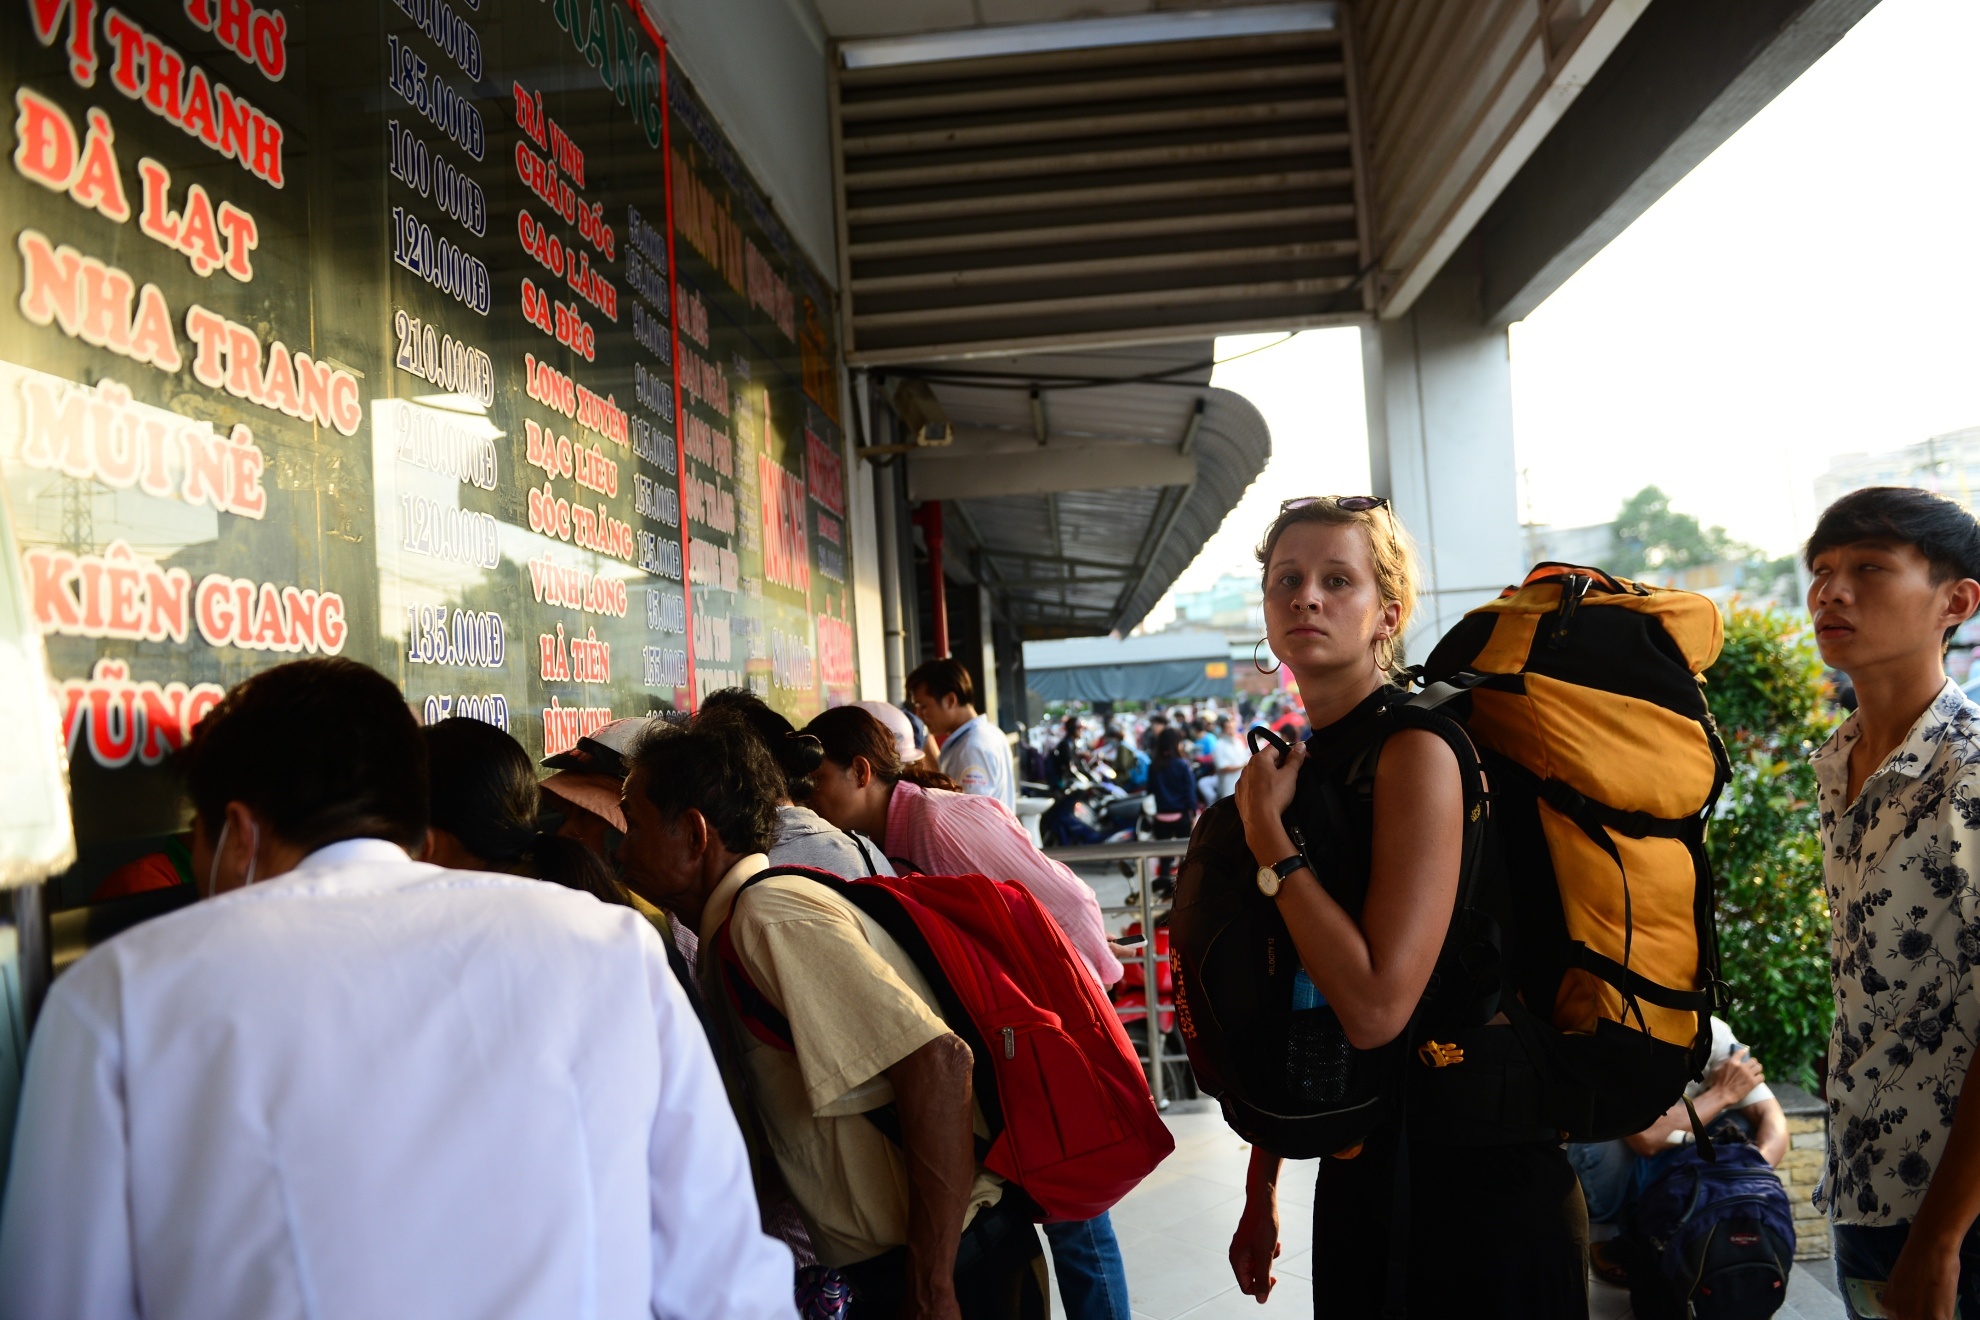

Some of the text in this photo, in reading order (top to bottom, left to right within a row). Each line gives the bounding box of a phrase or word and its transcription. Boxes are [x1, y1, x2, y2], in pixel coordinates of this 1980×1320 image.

[105, 8, 284, 189] THANH
[388, 34, 485, 162] 185.000Đ
[513, 80, 585, 190] TRÀ VINH
[15, 87, 258, 282] ĐÀ LẠT
[515, 140, 575, 226] CHÂU
[578, 202, 615, 263] ĐỐC
[392, 207, 490, 316] 120.000Đ
[518, 209, 564, 278] CAO
[18, 229, 362, 436] NHA TRANG
[395, 310, 494, 408] 210.000Đ
[521, 277, 595, 363] SA ĐÉC
[525, 352, 629, 449] LONG XUYÊN
[682, 407, 712, 468] LONG
[20, 378, 267, 520] MŨI NÉ
[398, 403, 497, 492] 210.000Đ
[525, 417, 617, 498] BẠC LIÊU
[631, 414, 677, 476] 115.000Đ
[400, 492, 501, 570] 120.000Đ
[527, 481, 633, 562] SÓC TRĂNG
[633, 472, 679, 528] 155.000Đ
[528, 550, 627, 618] VĨNH LONG
[637, 529, 681, 580] 125.000Đ
[22, 538, 348, 655] KIÊN GIANG
[406, 601, 506, 668] 135.000Đ
[646, 588, 685, 634] 95.000Đ
[540, 622, 610, 684] HÀ TIÊN
[642, 645, 687, 688] 155.000Đ
[543, 695, 578, 756] BÌNH
[1268, 946, 1276, 976] VELOCITY
